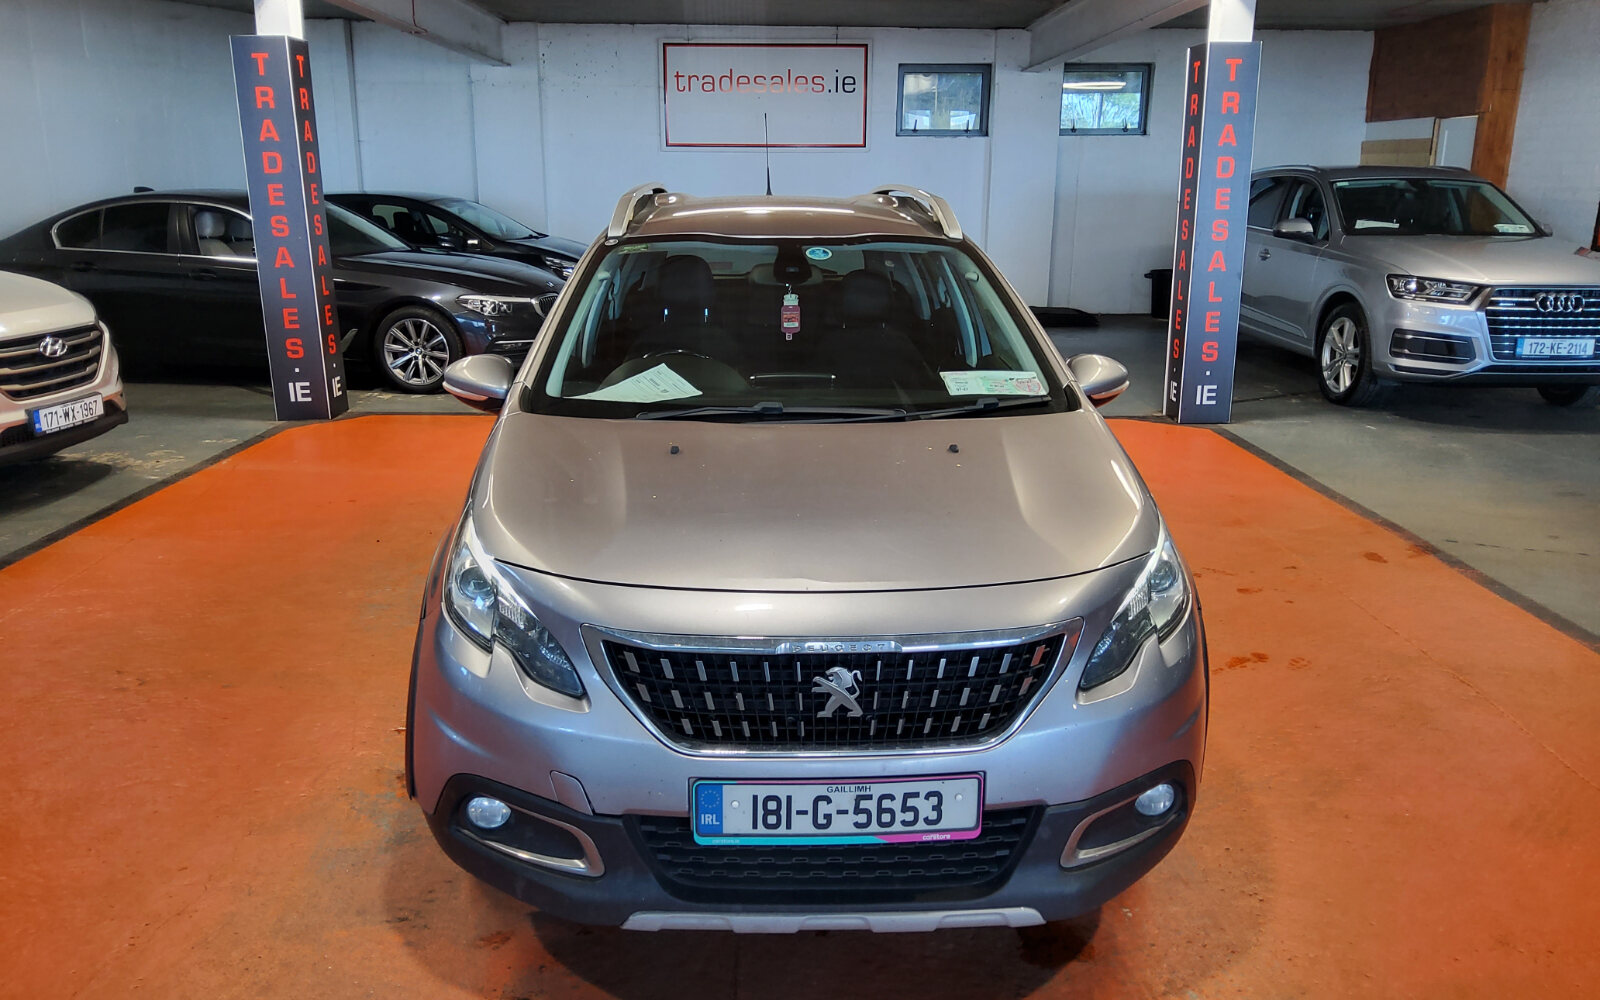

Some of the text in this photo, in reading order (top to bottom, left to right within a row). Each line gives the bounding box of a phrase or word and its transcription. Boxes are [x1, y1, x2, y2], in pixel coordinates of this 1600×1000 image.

[674, 68, 857, 94] tradesales.ie
[1528, 342, 1588, 355] 172-KE-2114
[43, 400, 98, 429] 171-WX-1967
[793, 643, 886, 653] PEUGEOT
[826, 785, 872, 794] GAILLIMH
[751, 790, 944, 830] 181-G-5653
[701, 813, 720, 825] IRL
